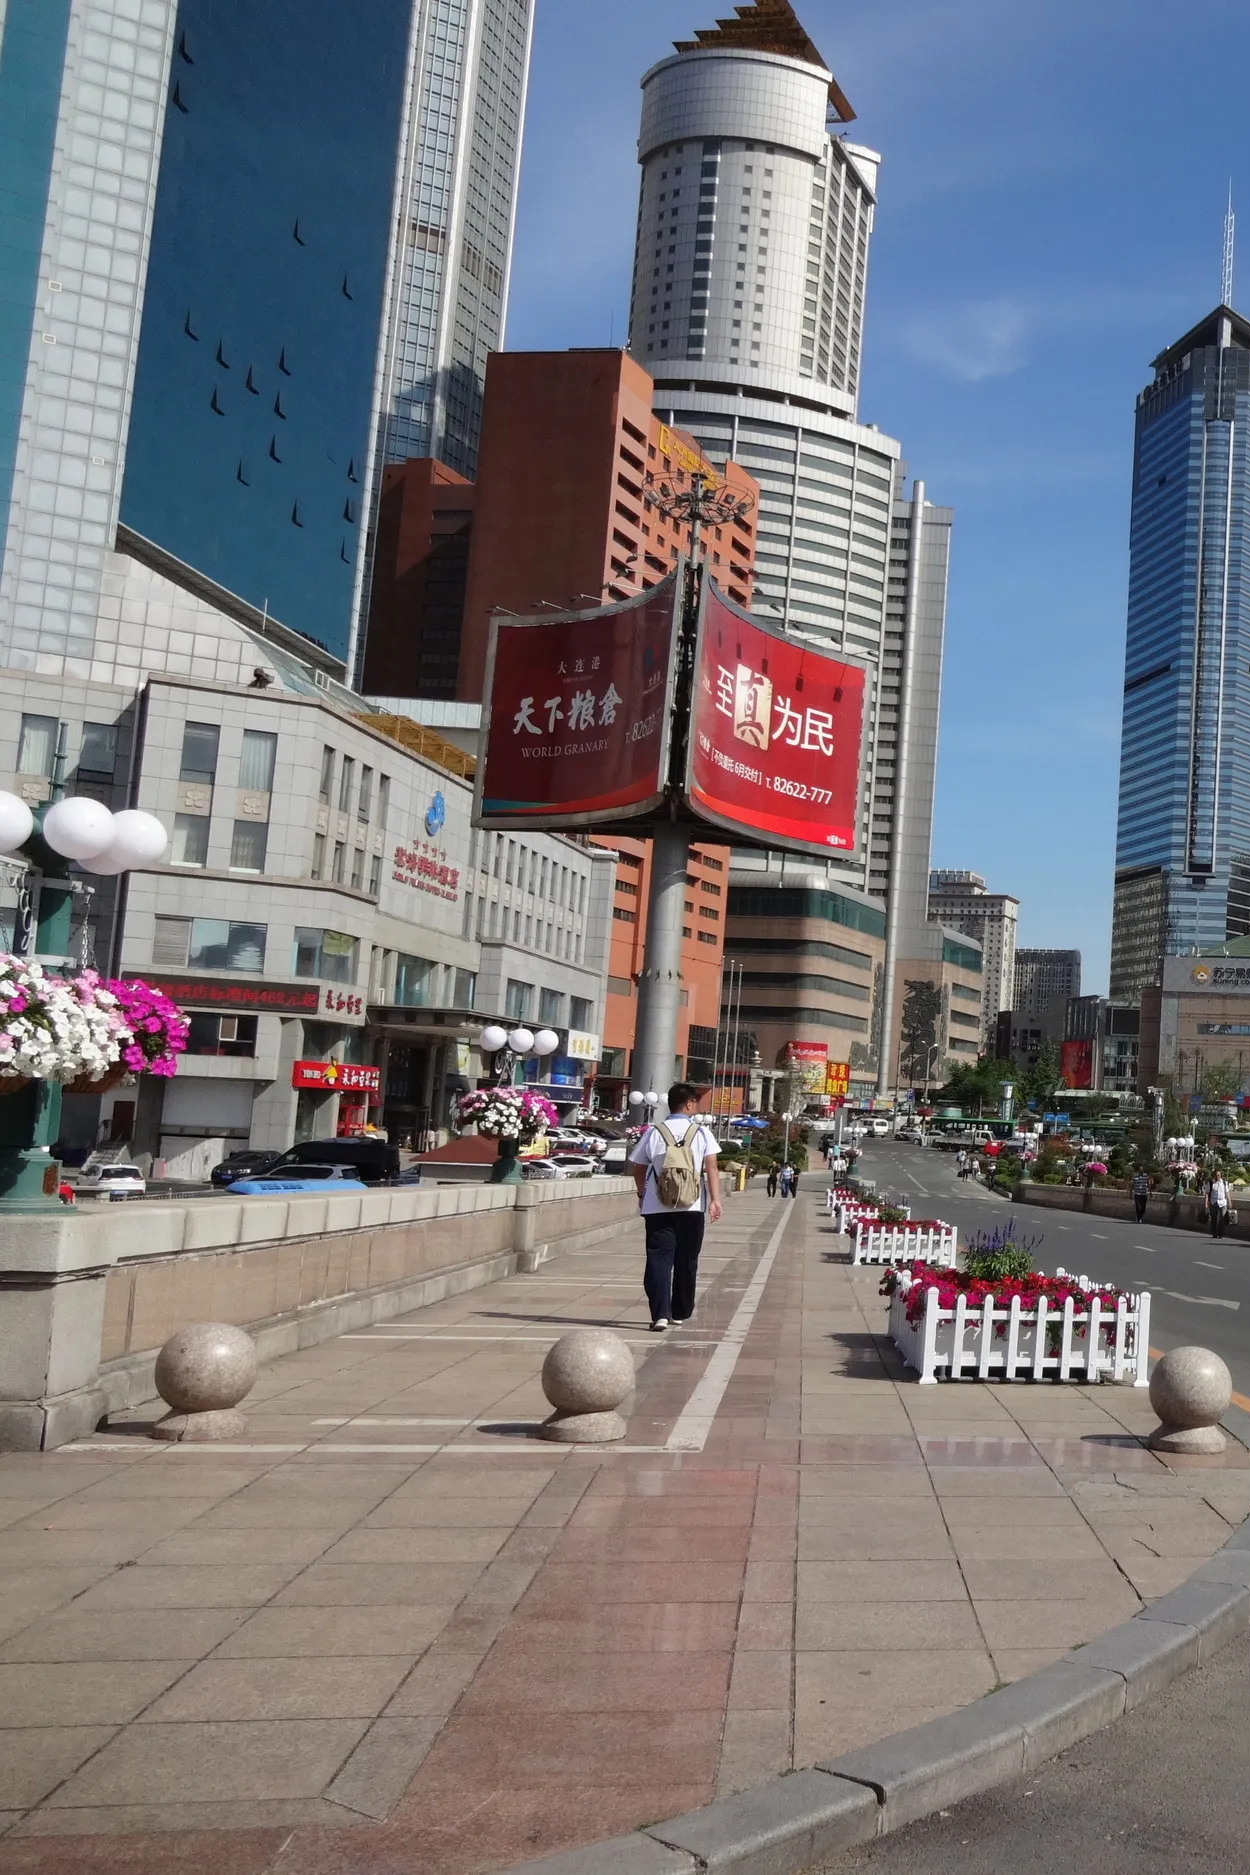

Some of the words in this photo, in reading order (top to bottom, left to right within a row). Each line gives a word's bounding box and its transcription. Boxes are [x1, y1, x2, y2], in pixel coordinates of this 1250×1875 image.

[521, 746, 562, 758] WORLD
[564, 738, 610, 755] GRANARY
[773, 776, 832, 805] 82622-777
